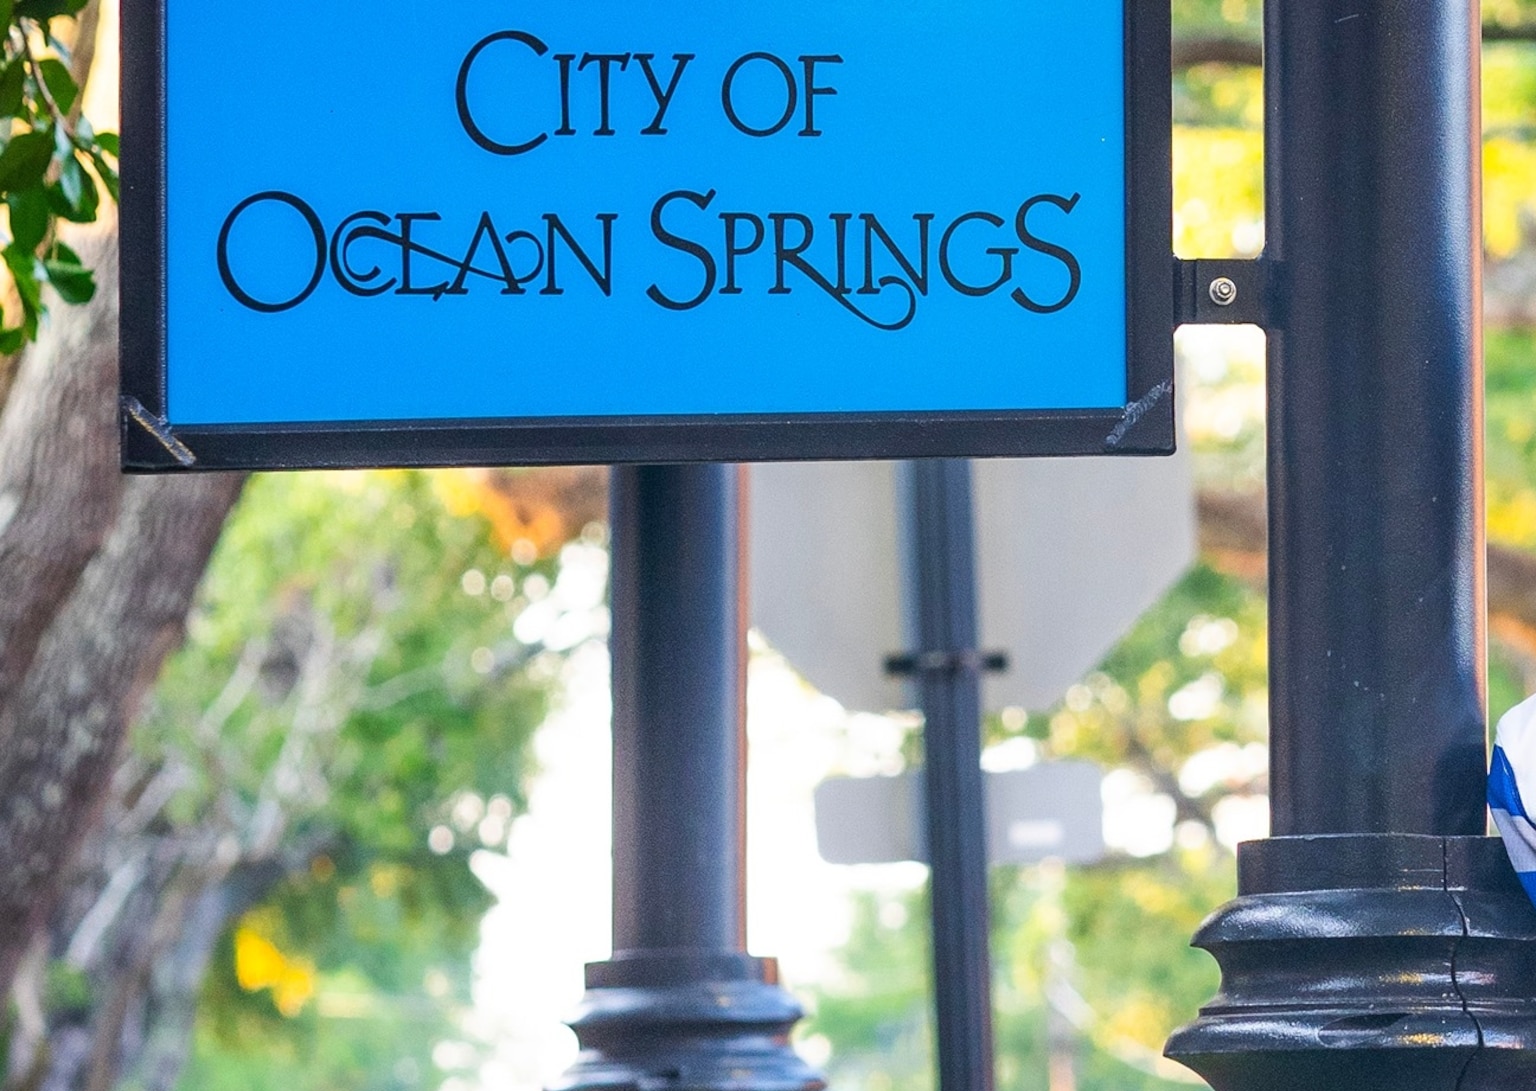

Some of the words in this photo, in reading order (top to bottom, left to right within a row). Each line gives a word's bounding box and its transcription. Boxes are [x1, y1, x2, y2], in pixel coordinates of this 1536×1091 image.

[455, 30, 695, 156] CITY
[721, 51, 843, 137] OF
[216, 190, 618, 313] OCEAN
[646, 189, 1081, 331] SPRINGS
